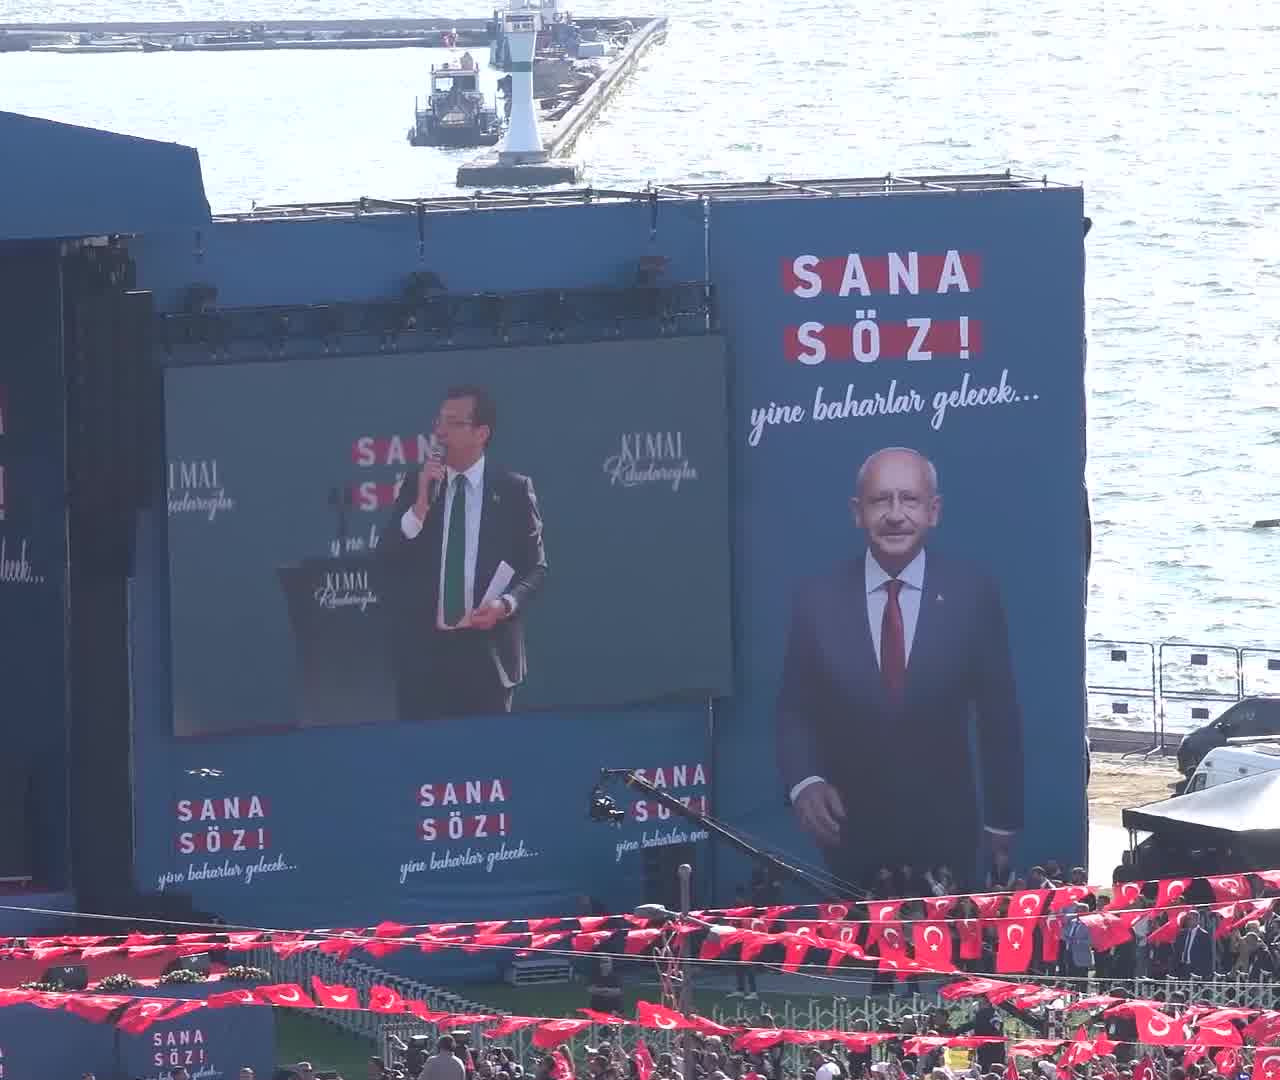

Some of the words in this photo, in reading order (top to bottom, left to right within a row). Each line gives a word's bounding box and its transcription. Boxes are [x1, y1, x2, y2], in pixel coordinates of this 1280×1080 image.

[792, 249, 971, 299] SANA
[796, 309, 970, 366] SÖZ!
[747, 400, 805, 447] yine
[812, 379, 925, 421] baharlar
[357, 434, 440, 467] SAN
[177, 795, 265, 822] SANA
[419, 779, 505, 807] SANA
[180, 825, 265, 854] SÖZ!
[422, 811, 505, 841] SÖZ!
[157, 871, 185, 892] yine
[188, 859, 242, 882] baharlar
[400, 859, 427, 884] yine
[430, 847, 484, 870] baharlar
[152, 1030, 203, 1046] SANA
[154, 1049, 205, 1066] SÖZ!
